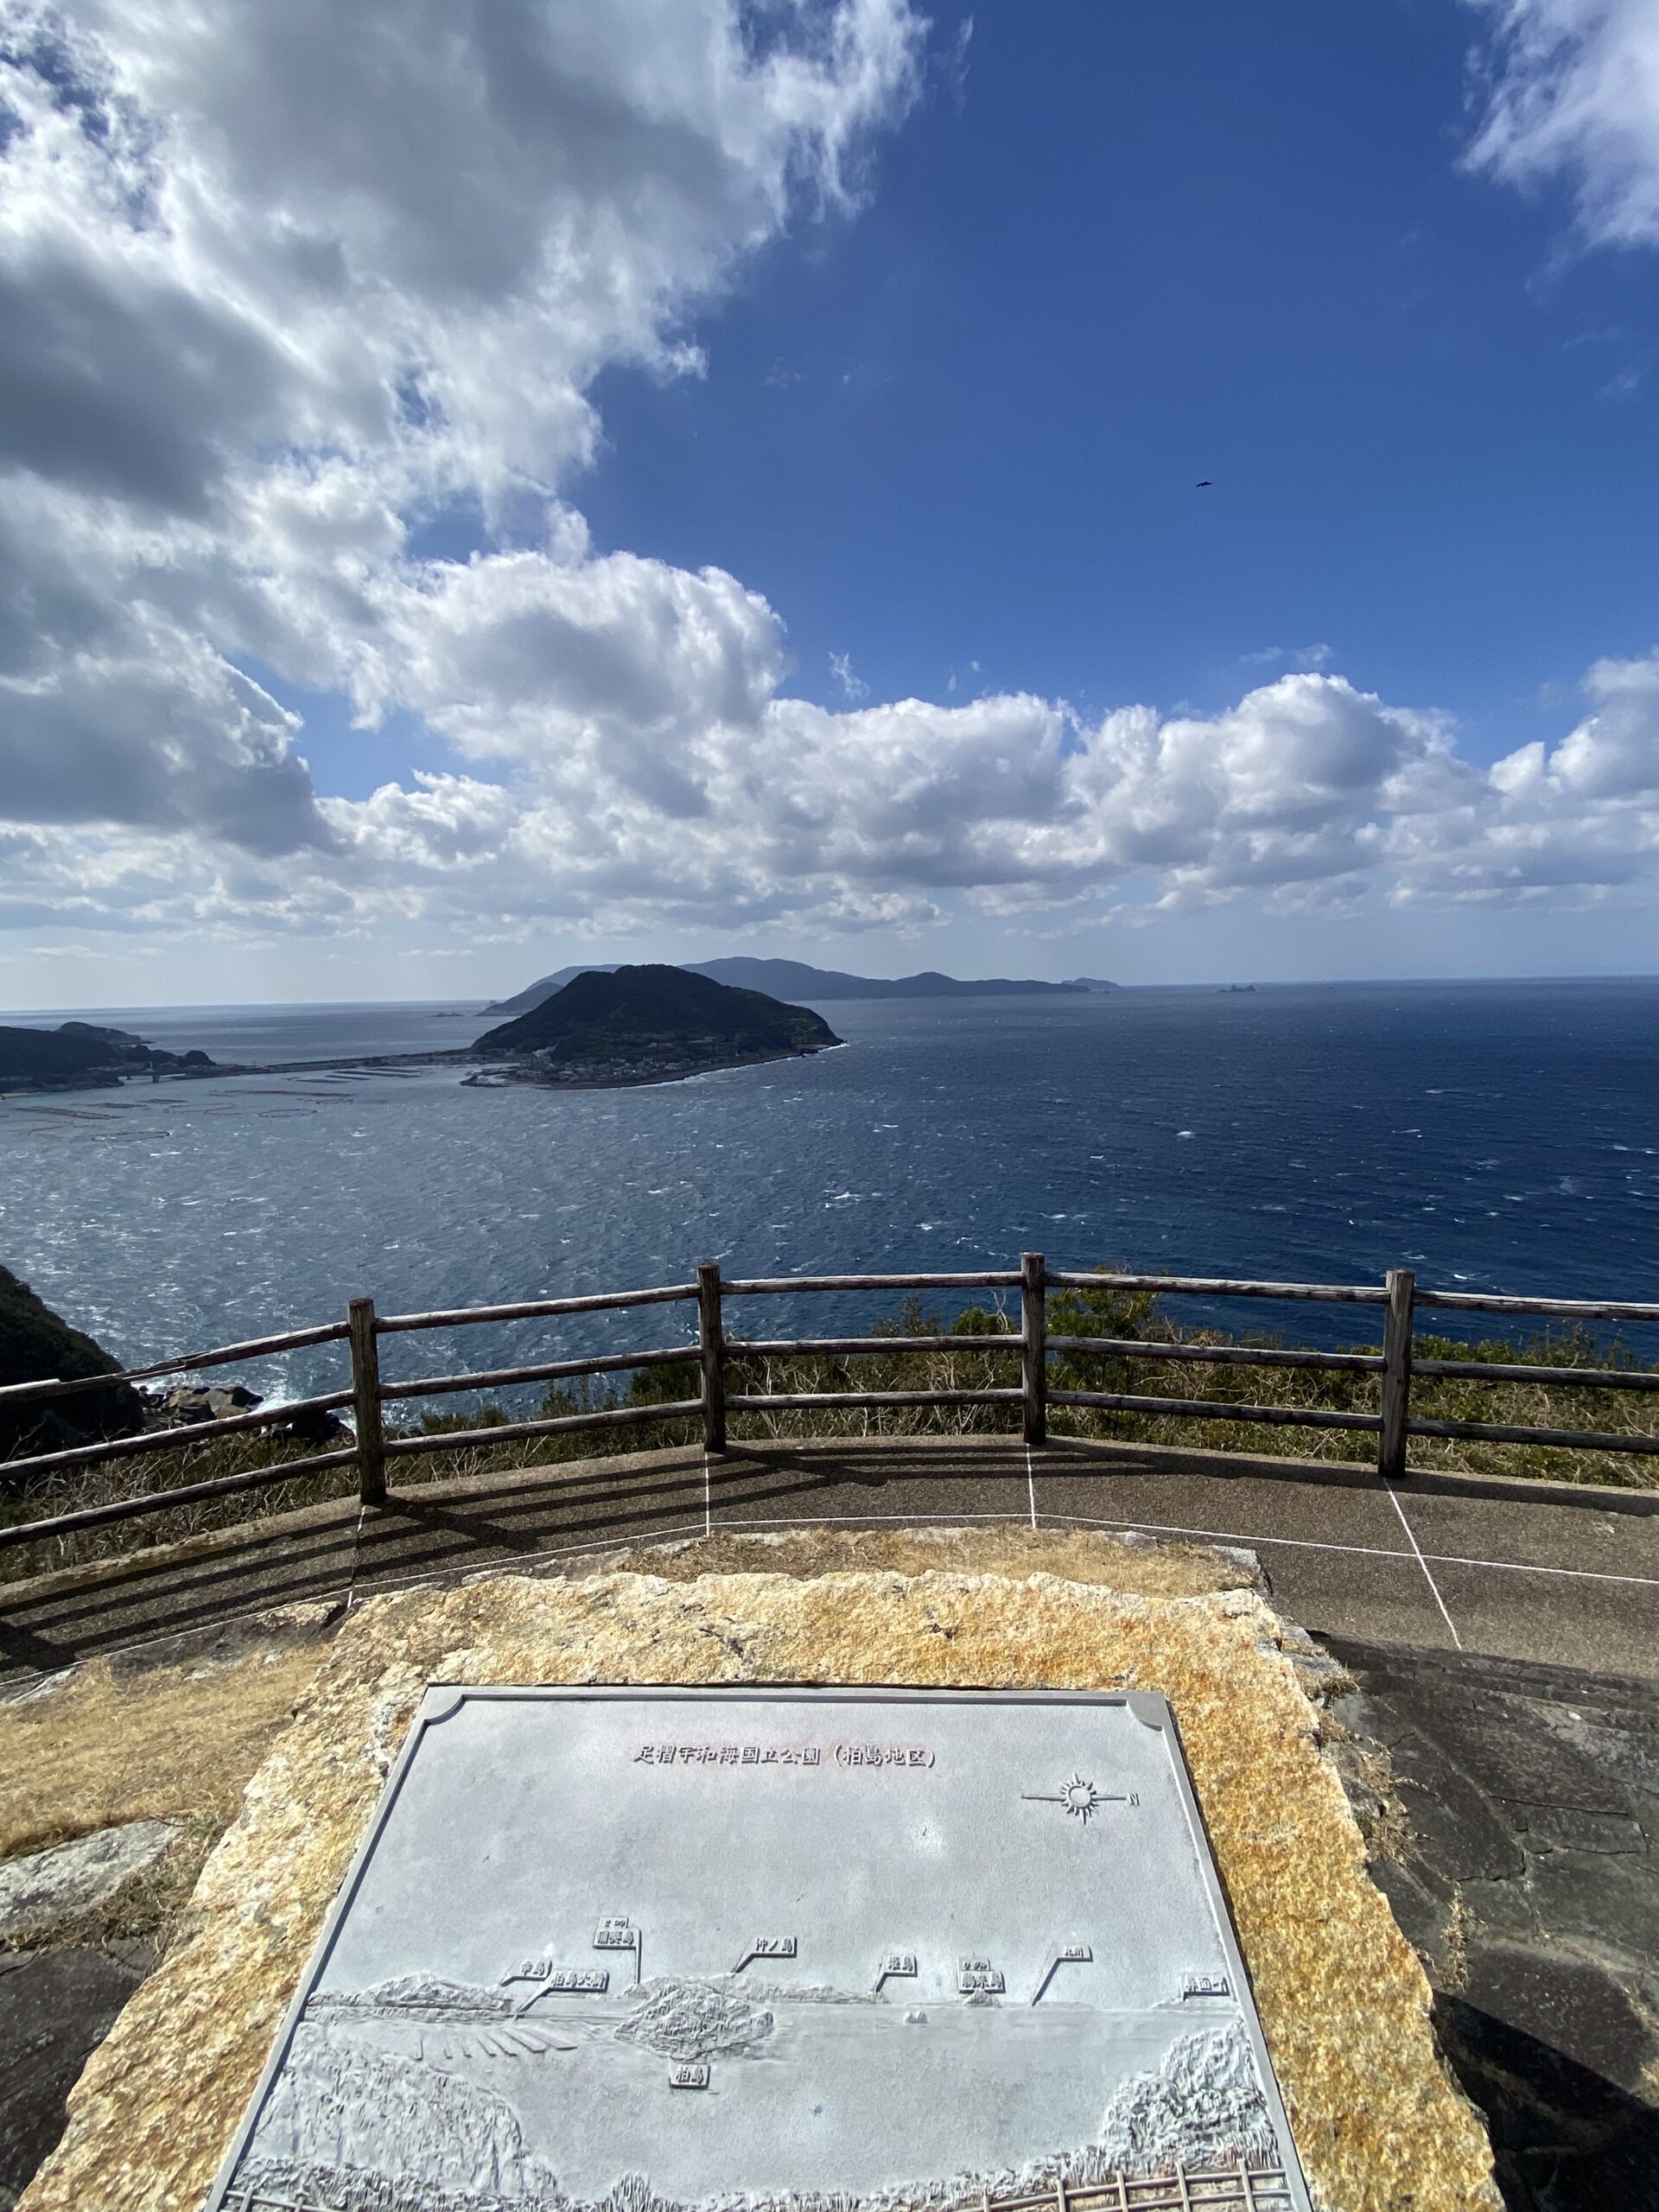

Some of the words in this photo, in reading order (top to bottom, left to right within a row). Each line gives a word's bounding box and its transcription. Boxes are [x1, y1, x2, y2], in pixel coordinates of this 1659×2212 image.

[1128, 1792, 1140, 1806] N
[754, 1936, 793, 1953] 沖ノ島
[676, 2065, 704, 2084] 柏島
